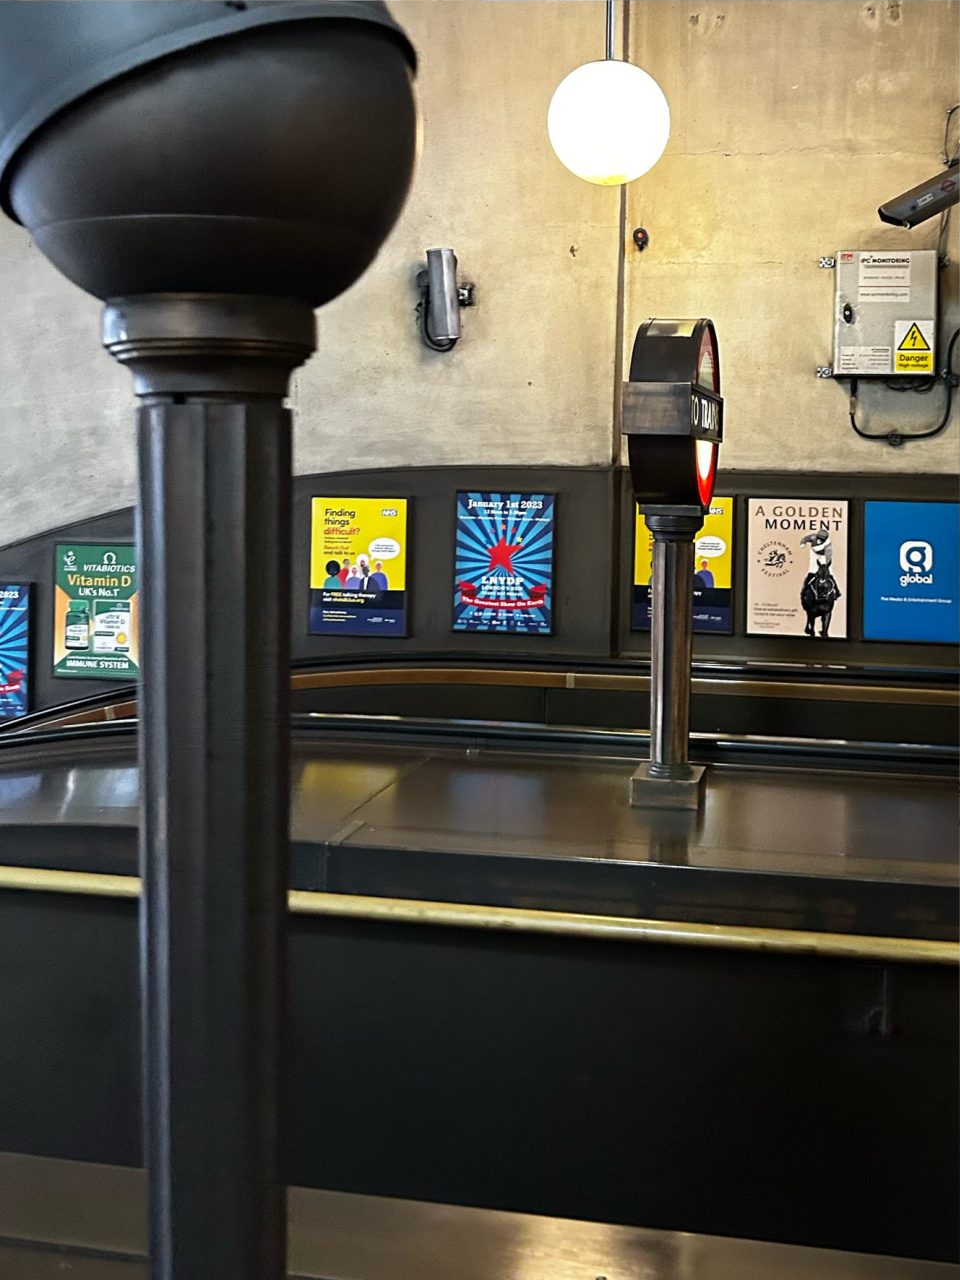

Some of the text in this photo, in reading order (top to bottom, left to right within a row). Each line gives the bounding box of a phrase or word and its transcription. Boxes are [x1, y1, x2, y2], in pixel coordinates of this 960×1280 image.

[899, 354, 929, 362] Danger
[467, 499, 543, 509] January 1st 2023
[324, 508, 356, 519] Finding
[755, 505, 843, 518] A GOLDEN
[324, 518, 350, 527] things
[765, 518, 842, 531] MOMENT
[324, 527, 360, 536] difficult?
[757, 540, 793, 556] CHELTENHAM
[83, 564, 136, 573] VITABIOTICS
[761, 568, 790, 578] FESTIVAL
[67, 574, 132, 587] Vitamin D
[481, 576, 525, 585] LNYDP
[900, 573, 933, 587] global
[78, 587, 98, 597] UK's
[66, 659, 129, 669] IMMUNE SYSTEM
